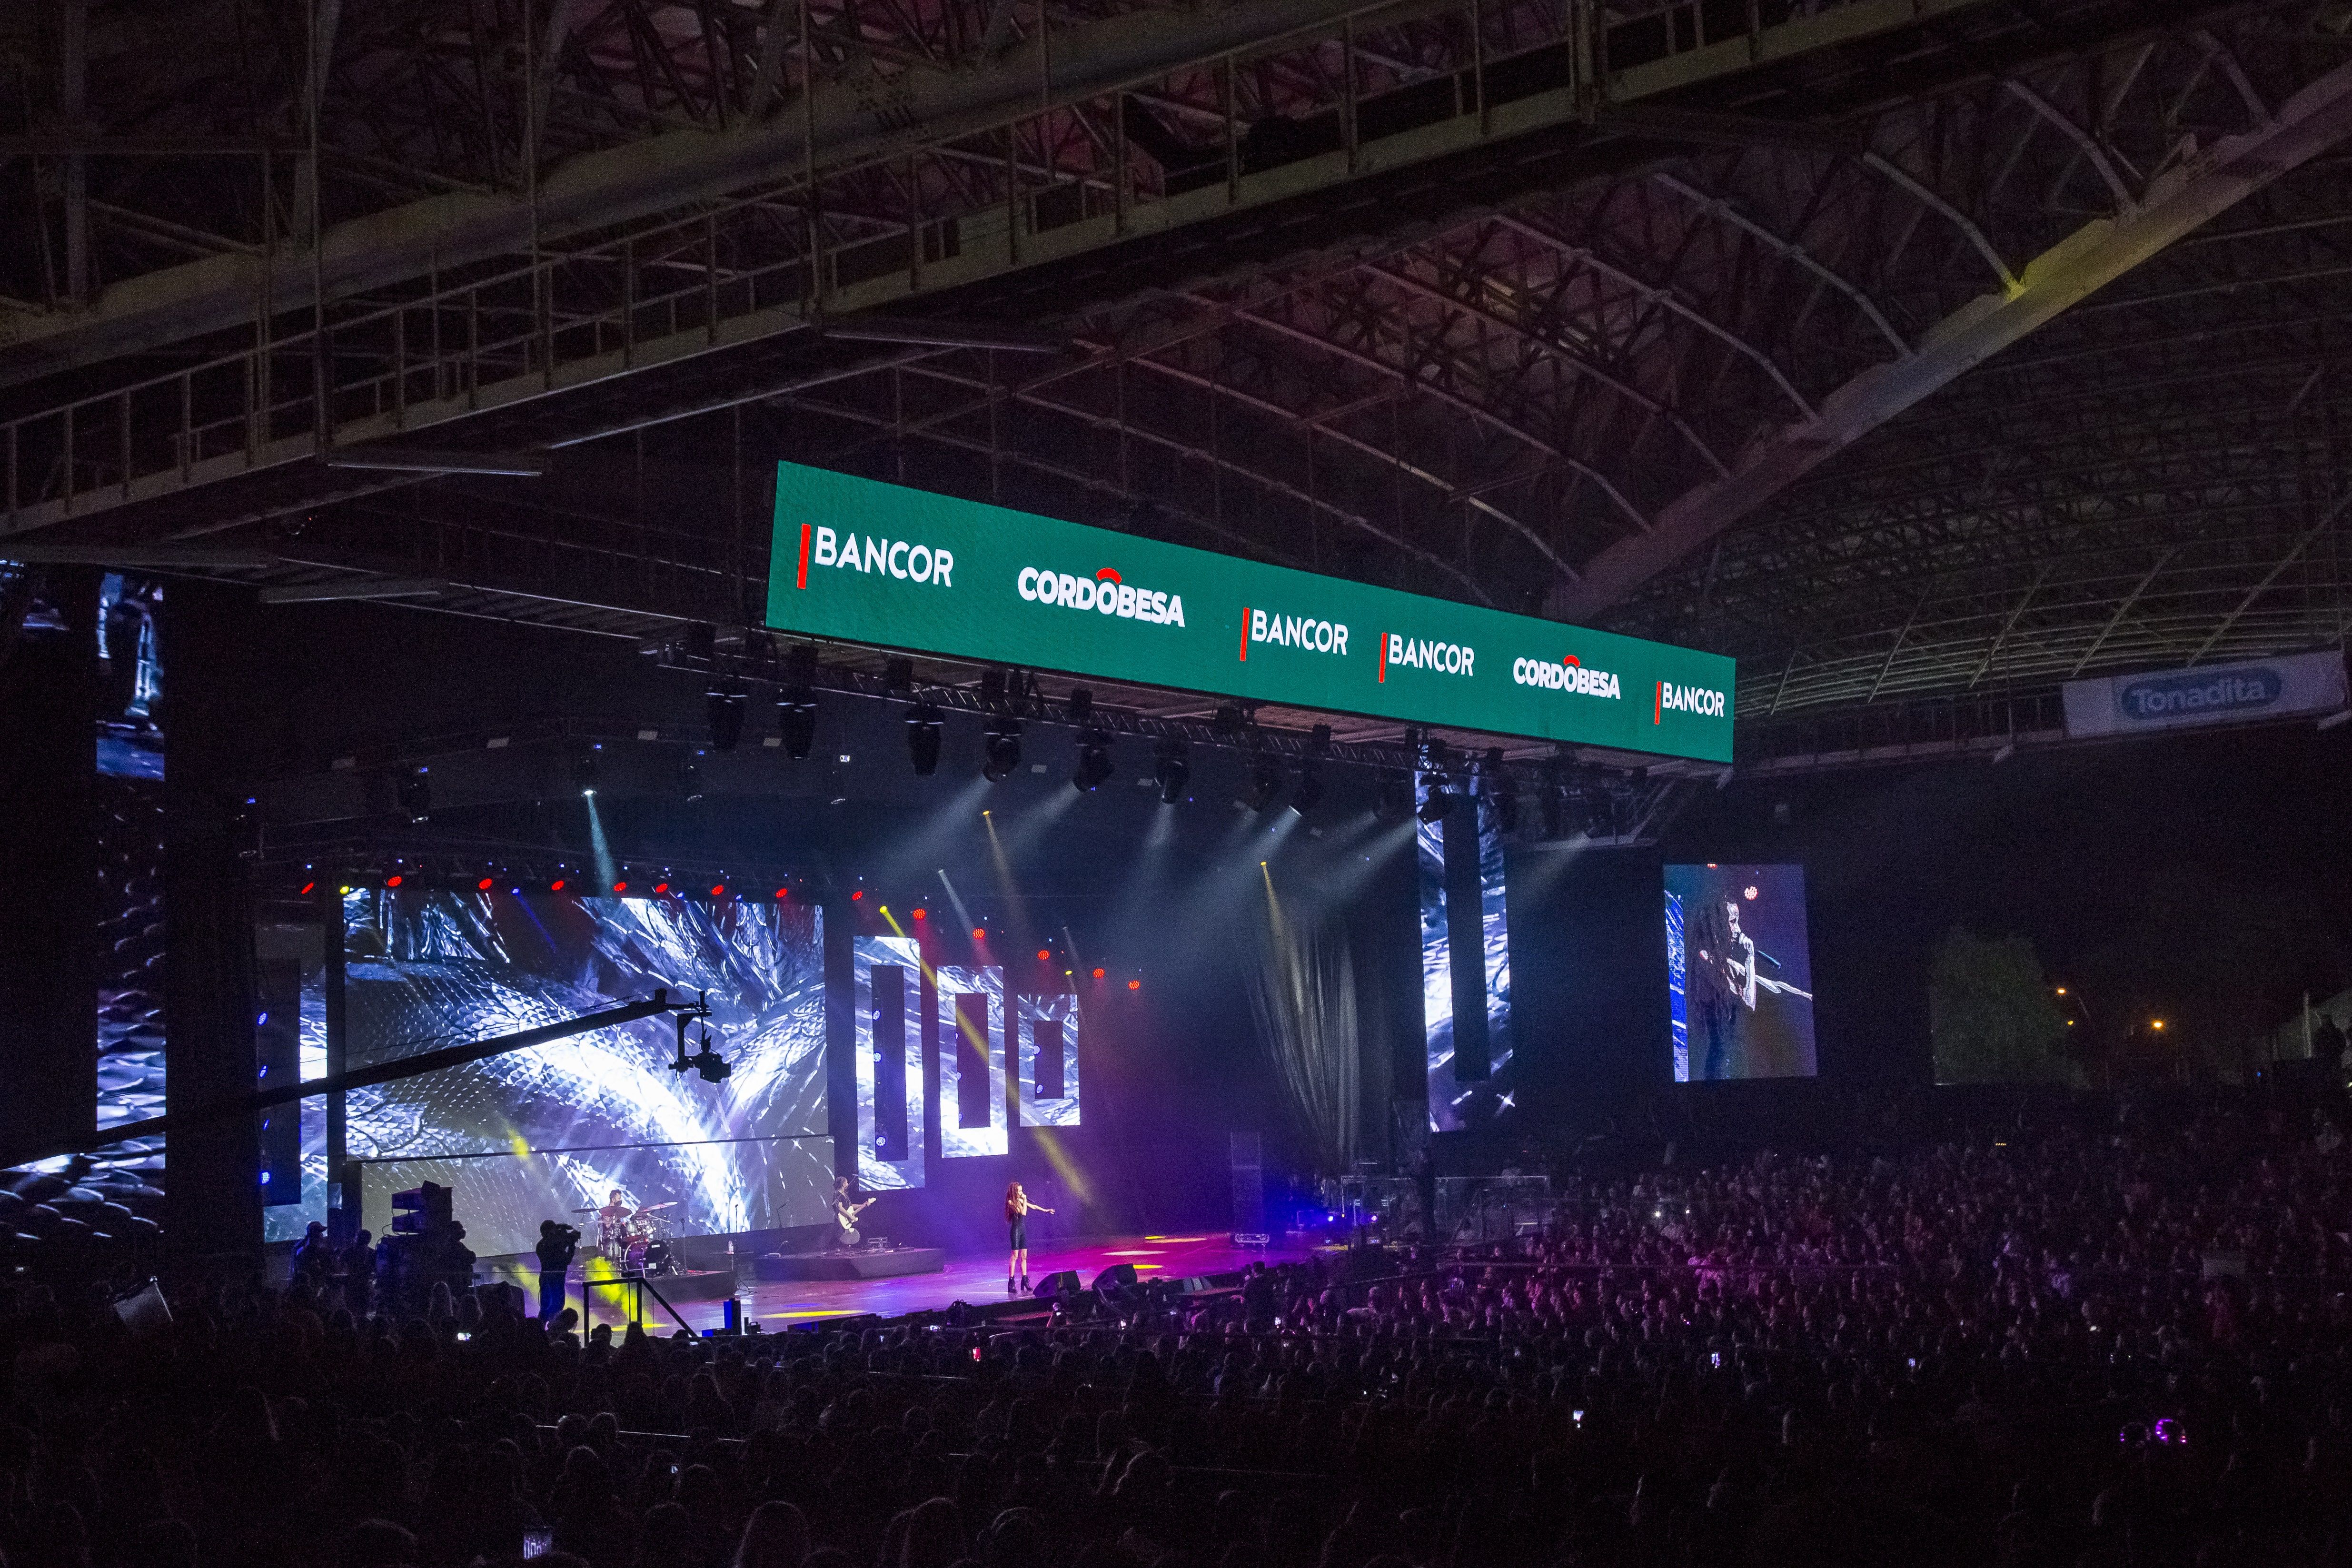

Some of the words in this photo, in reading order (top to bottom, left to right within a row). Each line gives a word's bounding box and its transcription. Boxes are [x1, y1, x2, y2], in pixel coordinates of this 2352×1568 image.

[814, 526, 953, 587] BANCOR
[1251, 609, 1349, 656] BANCOR
[1389, 634, 1474, 676] BANCOR
[1662, 682, 1725, 718] BANCOR
[2132, 679, 2265, 714] Tonadita
